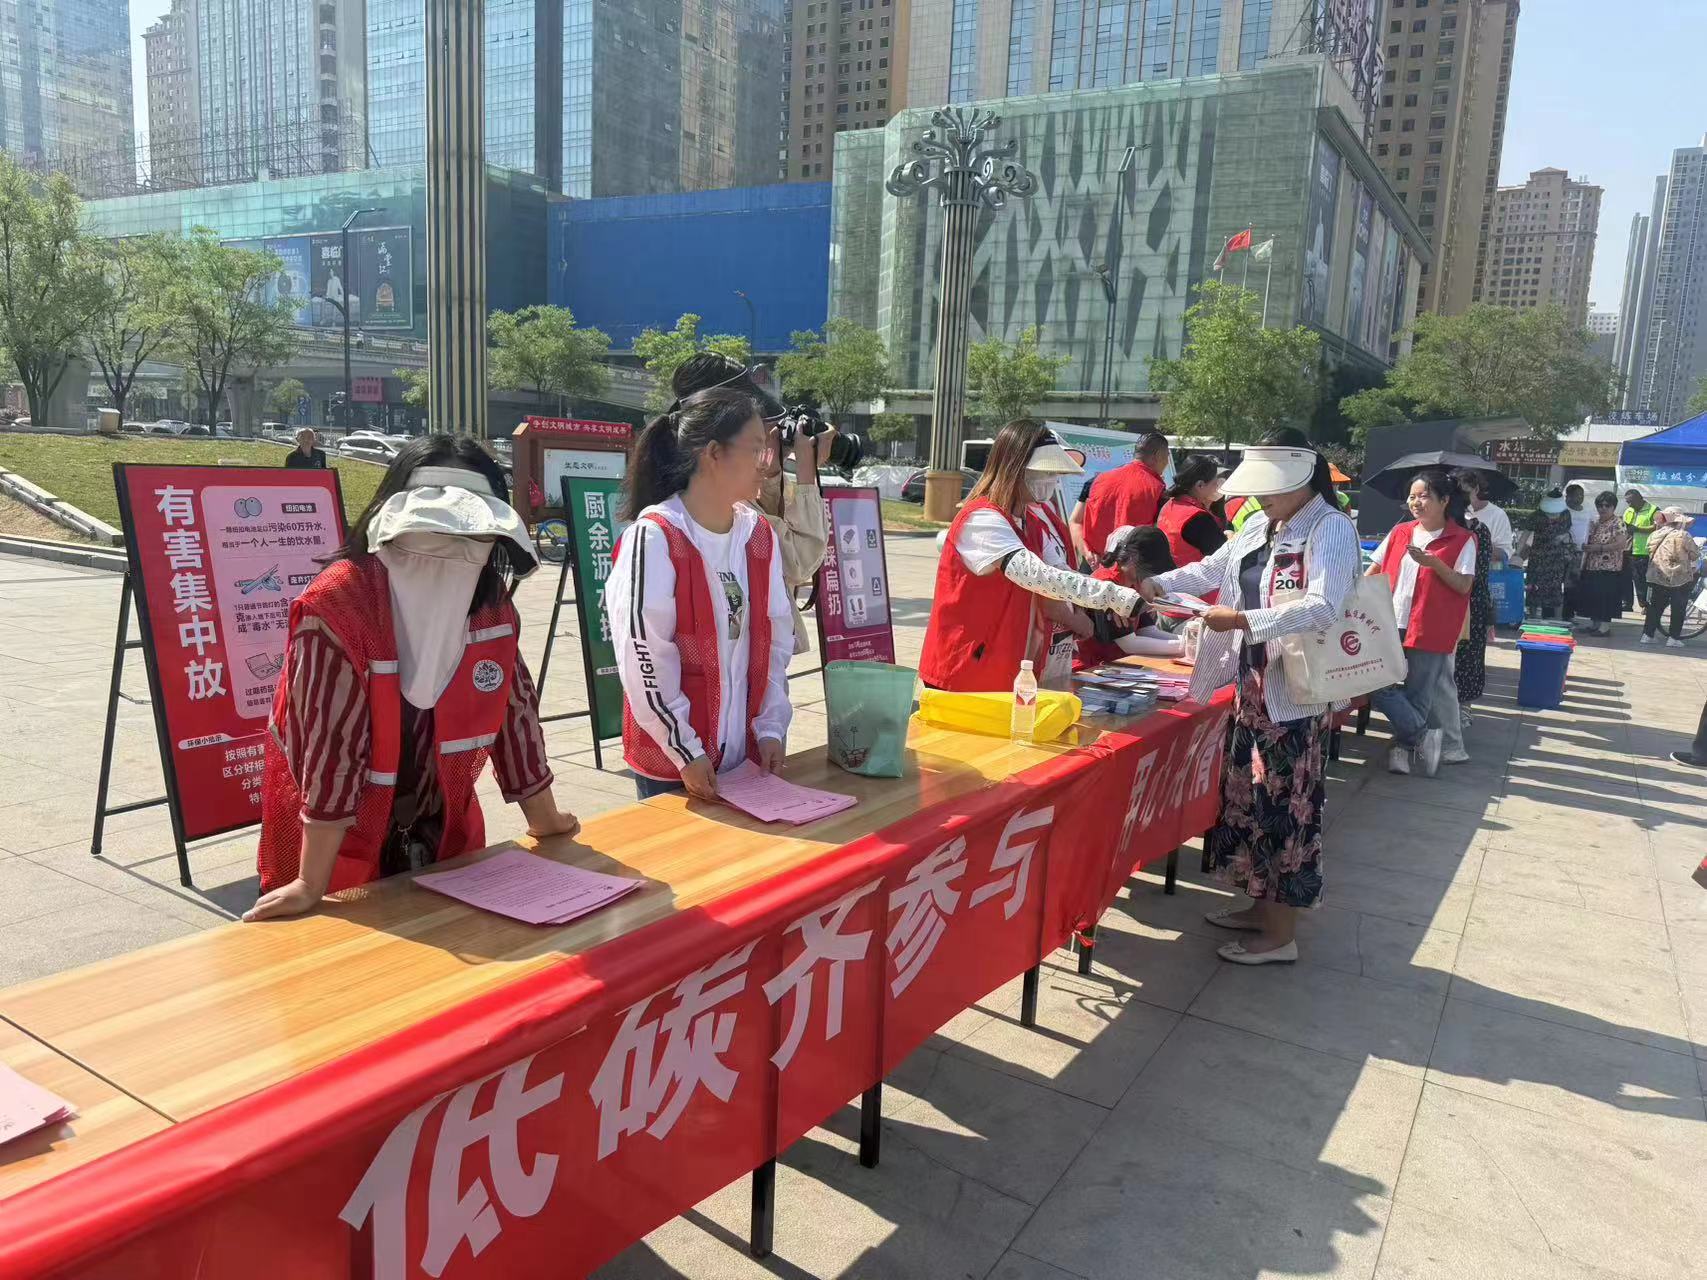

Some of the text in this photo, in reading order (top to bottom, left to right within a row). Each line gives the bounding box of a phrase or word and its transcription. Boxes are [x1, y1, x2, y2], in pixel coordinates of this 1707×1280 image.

[154, 485, 227, 701] 有害集中放
[245, 684, 277, 697] 过期药品
[634, 641, 658, 689] FIGHT
[339, 804, 1056, 1280] 低碳齐参与
